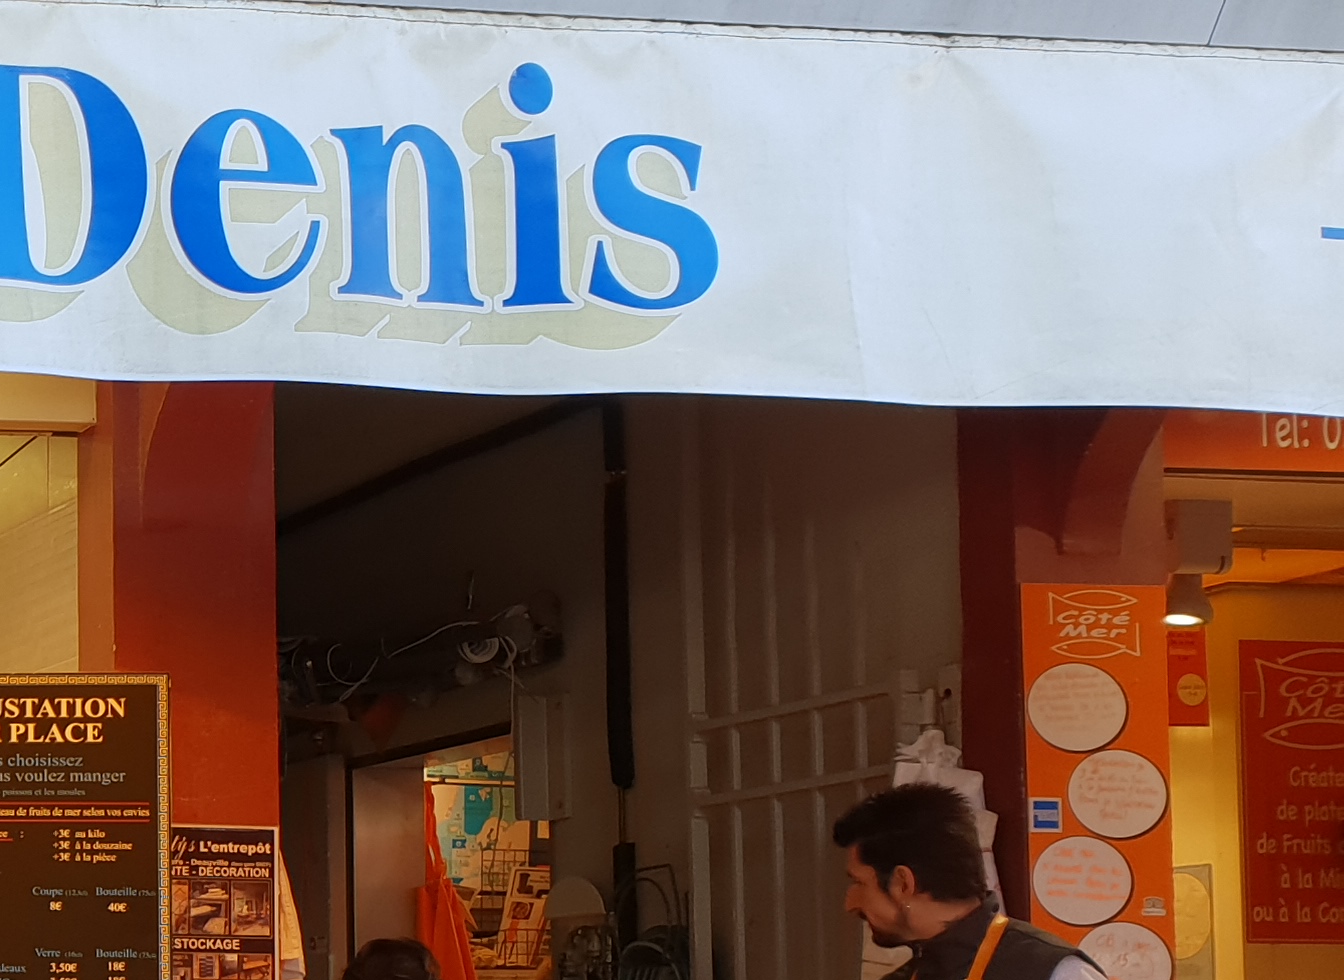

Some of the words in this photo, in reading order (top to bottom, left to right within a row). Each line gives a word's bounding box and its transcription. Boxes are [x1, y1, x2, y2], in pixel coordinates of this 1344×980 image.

[1056, 610, 1132, 625] Côté
[1059, 624, 1128, 638] Mer
[9, 723, 103, 742] PLACE
[8, 753, 83, 766] choisissez
[16, 769, 65, 782] voulez
[70, 773, 126, 785] manger
[199, 840, 271, 856] L'entrepôt
[1257, 833, 1277, 853] de
[1283, 834, 1331, 854] Fruits
[32, 887, 63, 898] Coupe
[96, 887, 137, 896] Bouteille
[50, 902, 62, 910] 8€
[108, 903, 127, 912] 40€
[173, 938, 241, 950] STOCKAGE
[35, 948, 60, 957] Verre
[96, 949, 137, 958] Bouteille
[50, 963, 77, 973] 3,50€
[109, 962, 125, 971] 18€
